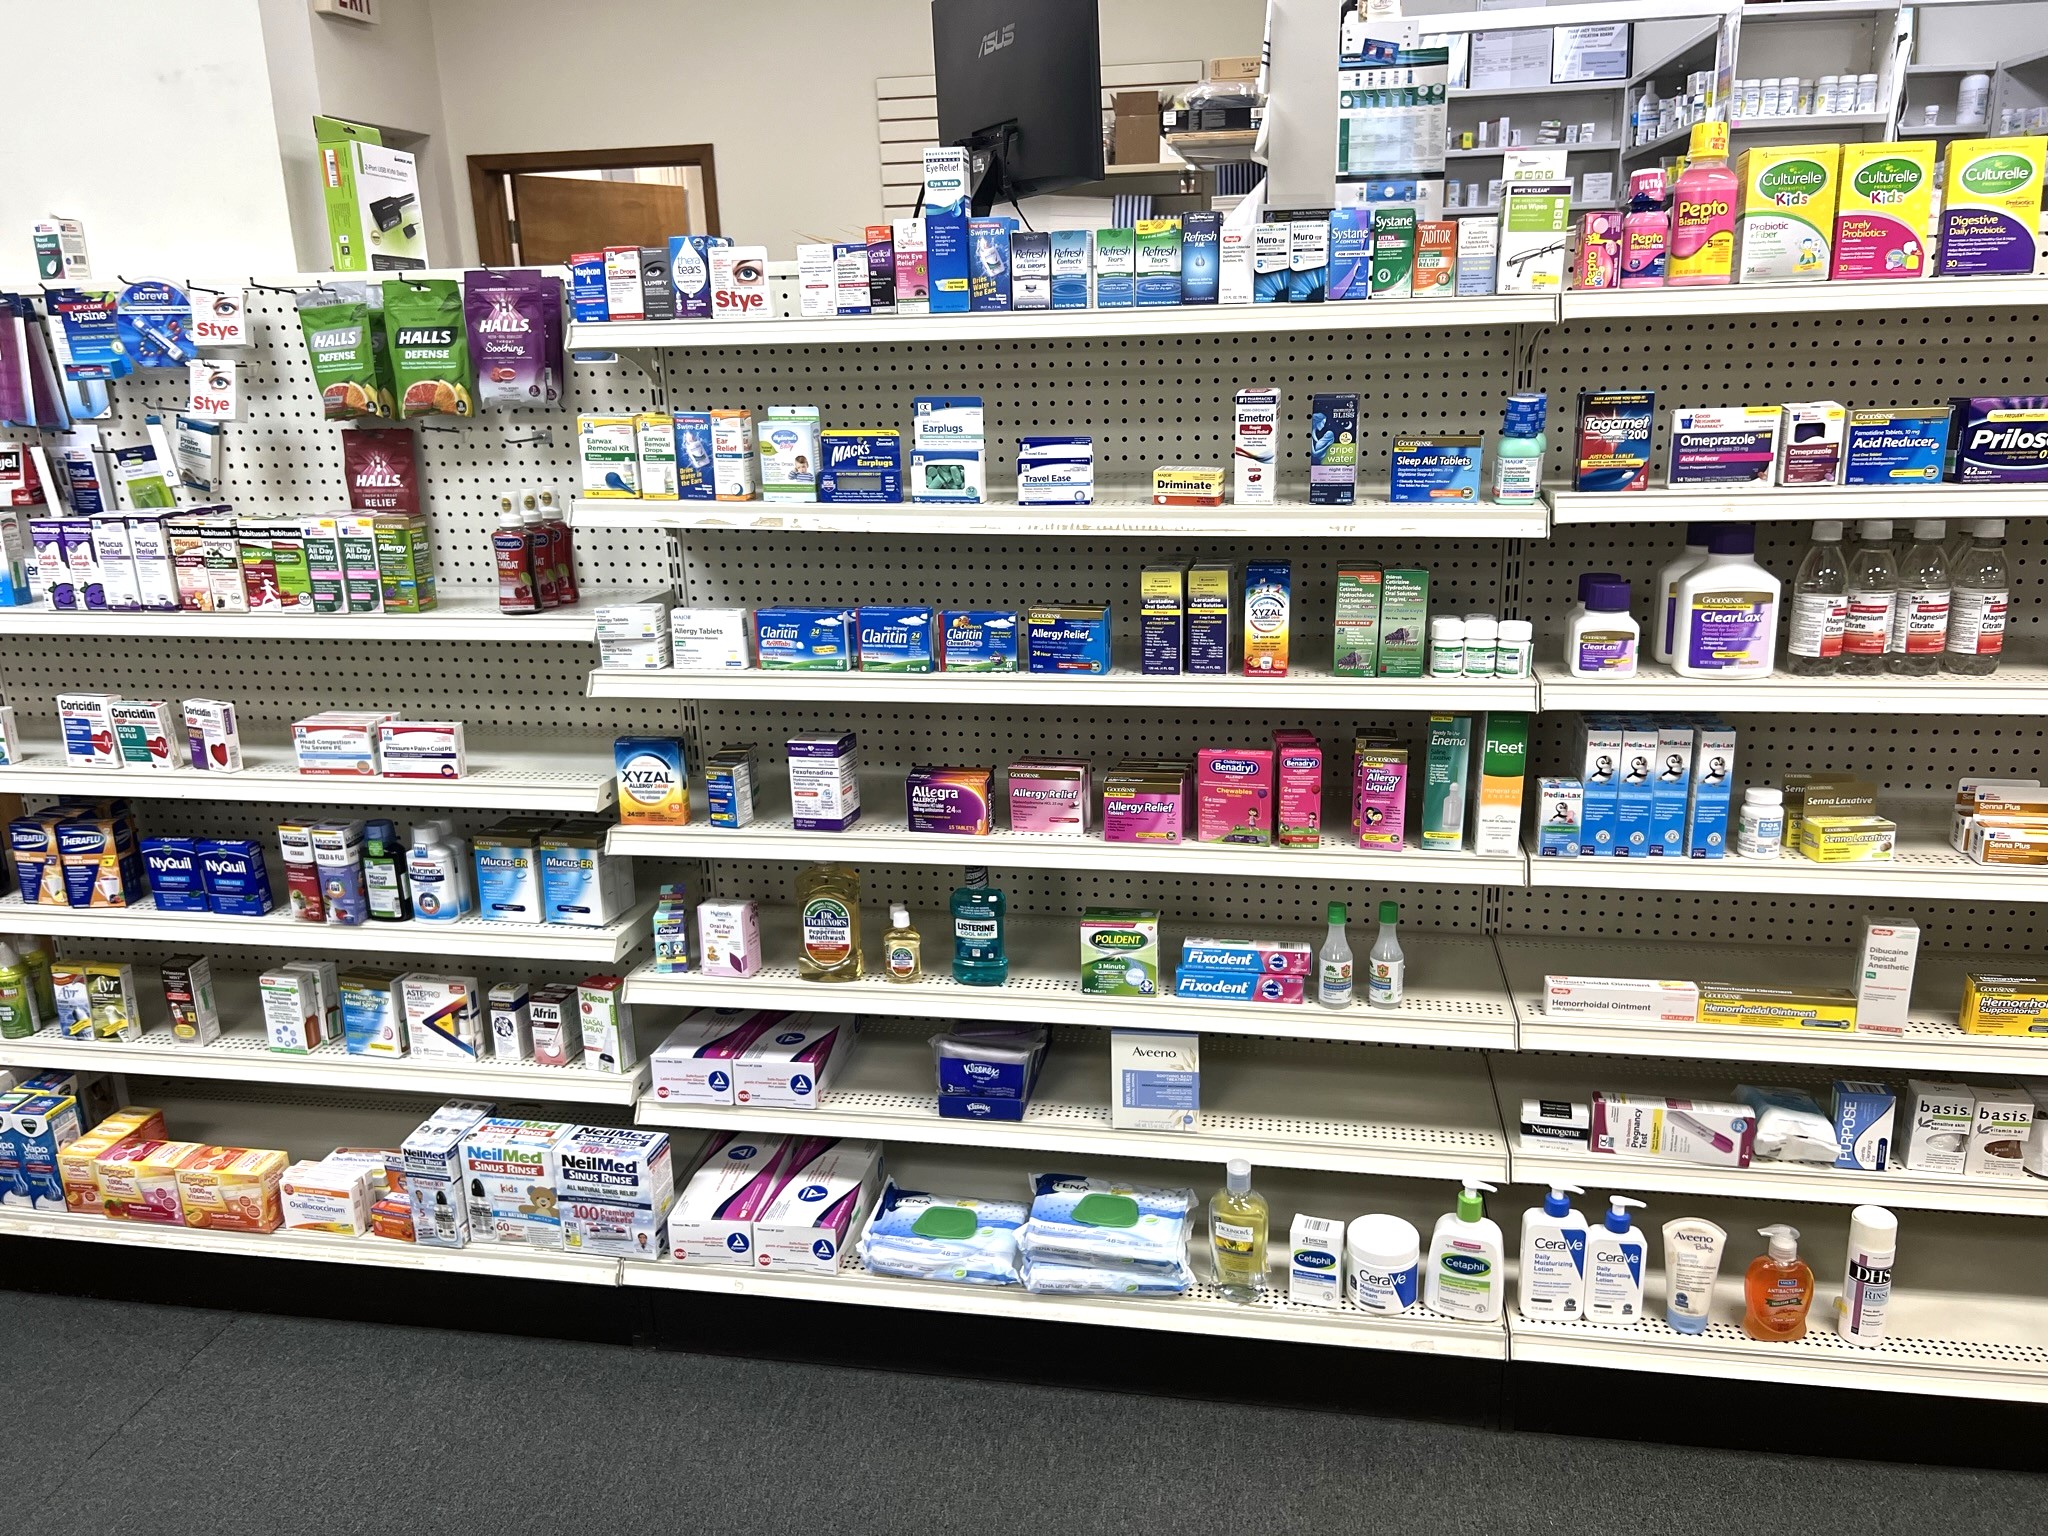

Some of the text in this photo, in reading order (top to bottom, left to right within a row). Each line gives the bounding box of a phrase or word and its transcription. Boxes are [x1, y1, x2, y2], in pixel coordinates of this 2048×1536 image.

[978, 23, 1015, 59] ASUS
[1763, 172, 1821, 186] Culturelle
[1858, 172, 1917, 184] Culturelle
[1967, 167, 2028, 182] Culturelle
[1775, 191, 1808, 206] Kids
[1872, 191, 1903, 204] Kids
[1679, 201, 1728, 217] Pepto
[1376, 216, 1412, 232] Systane
[1750, 222, 1788, 231] Probiotic
[1843, 221, 1871, 231] Purely
[1951, 215, 1998, 226] Digestive
[1332, 228, 1368, 240] Systane
[1949, 226, 2006, 235] Daily Probiotic
[1183, 233, 1217, 243] Refresh
[1293, 233, 1313, 241] Muro
[1631, 234, 1663, 247] Pepto
[1016, 249, 1046, 259] Refresh
[1054, 249, 1084, 259] Refresh
[1100, 247, 1131, 256] Refresh
[1142, 248, 1177, 257] Refresh
[678, 265, 701, 275] tears
[1946, 260, 1957, 268] 30
[133, 292, 168, 301] abreva
[716, 290, 762, 313] Stye
[197, 323, 238, 340] Stye
[399, 331, 451, 344] HALLS
[315, 332, 356, 347] HALLS
[319, 351, 356, 362] DEFENSE
[405, 350, 449, 359] DEFENSE
[194, 396, 230, 414] Stye
[1238, 414, 1274, 422] Emetrol
[1586, 416, 1650, 432] Tagamet
[922, 424, 963, 434] Earplugs
[587, 437, 612, 445] Earwax
[644, 435, 666, 443] Earwax
[1680, 434, 1755, 447] Omeprazole
[1853, 436, 1933, 449] Acid Reducer
[1330, 446, 1353, 456] gripe
[857, 459, 893, 468] Earplugs
[1327, 454, 1353, 462] water
[1397, 456, 1471, 468] Sleep Aid Tablets
[1964, 467, 1977, 475] 42
[1157, 480, 1212, 490] Driminate
[270, 530, 301, 538] Robitussin
[134, 541, 158, 549] Mucus
[136, 547, 158, 555] Relief
[310, 554, 334, 562] Allergy
[1251, 608, 1283, 617] XYZAL
[1701, 612, 1762, 622] ClearLax
[674, 628, 697, 636] Allergy
[760, 626, 798, 639] Claritin
[862, 629, 908, 646] Claritin
[947, 629, 983, 639] Claritin
[1032, 629, 1088, 643] Allergy Relief
[61, 700, 101, 711] Coricidin
[185, 705, 211, 718] Coricidin
[112, 708, 156, 720] Coricidin
[1431, 736, 1466, 747] Enema
[1487, 741, 1524, 754] Fleet
[1215, 762, 1253, 774] Benadryl
[1287, 759, 1316, 768] Benadryl
[621, 771, 670, 783] XYZAL
[1367, 773, 1401, 787] Allergy
[1365, 782, 1395, 793] Liquid
[912, 786, 959, 803] Allegra
[1013, 788, 1078, 800] Allergy Relief
[1807, 796, 1872, 805] Senna Laxative
[1108, 801, 1174, 813] Allergy Relief
[1823, 833, 1891, 844] Senna Laxative
[150, 856, 192, 871] NyQuil
[206, 859, 246, 874] NyQuil
[809, 929, 845, 937] Peppermint
[957, 923, 995, 932] LISTERINE
[1187, 951, 1252, 967] Fixodent
[1868, 962, 1909, 971] Anesthetic
[1179, 978, 1249, 995] Fixodent
[1552, 999, 1650, 1011] Hemorrhoidal Ointment
[1704, 1003, 1816, 1018] Hemorrhoidal Ointment
[533, 1007, 558, 1019] Afrin
[1133, 1046, 1176, 1058] Aveeno
[963, 1064, 999, 1077] Kleenex
[948, 1085, 953, 1093] 3
[1920, 1101, 1968, 1115] basis
[1980, 1107, 2027, 1121] basis
[1532, 1124, 1580, 1137] Neutrogena
[1839, 1101, 1857, 1161] PURPOSE
[23, 1142, 48, 1156] Vapo
[403, 1148, 445, 1159] NeilMed
[468, 1146, 542, 1164] NeilMed
[562, 1155, 637, 1173] NeilMed
[569, 1171, 632, 1185] SINUS RINSE
[572, 1205, 599, 1220] 100
[1673, 1231, 1714, 1243] Aveeno
[1535, 1237, 1583, 1251] CeraVe
[1298, 1254, 1331, 1266] Cetaphil
[1446, 1258, 1485, 1272] Cetaphil
[1360, 1269, 1406, 1285] CeraVe
[1596, 1271, 1631, 1279] Moisturizing
